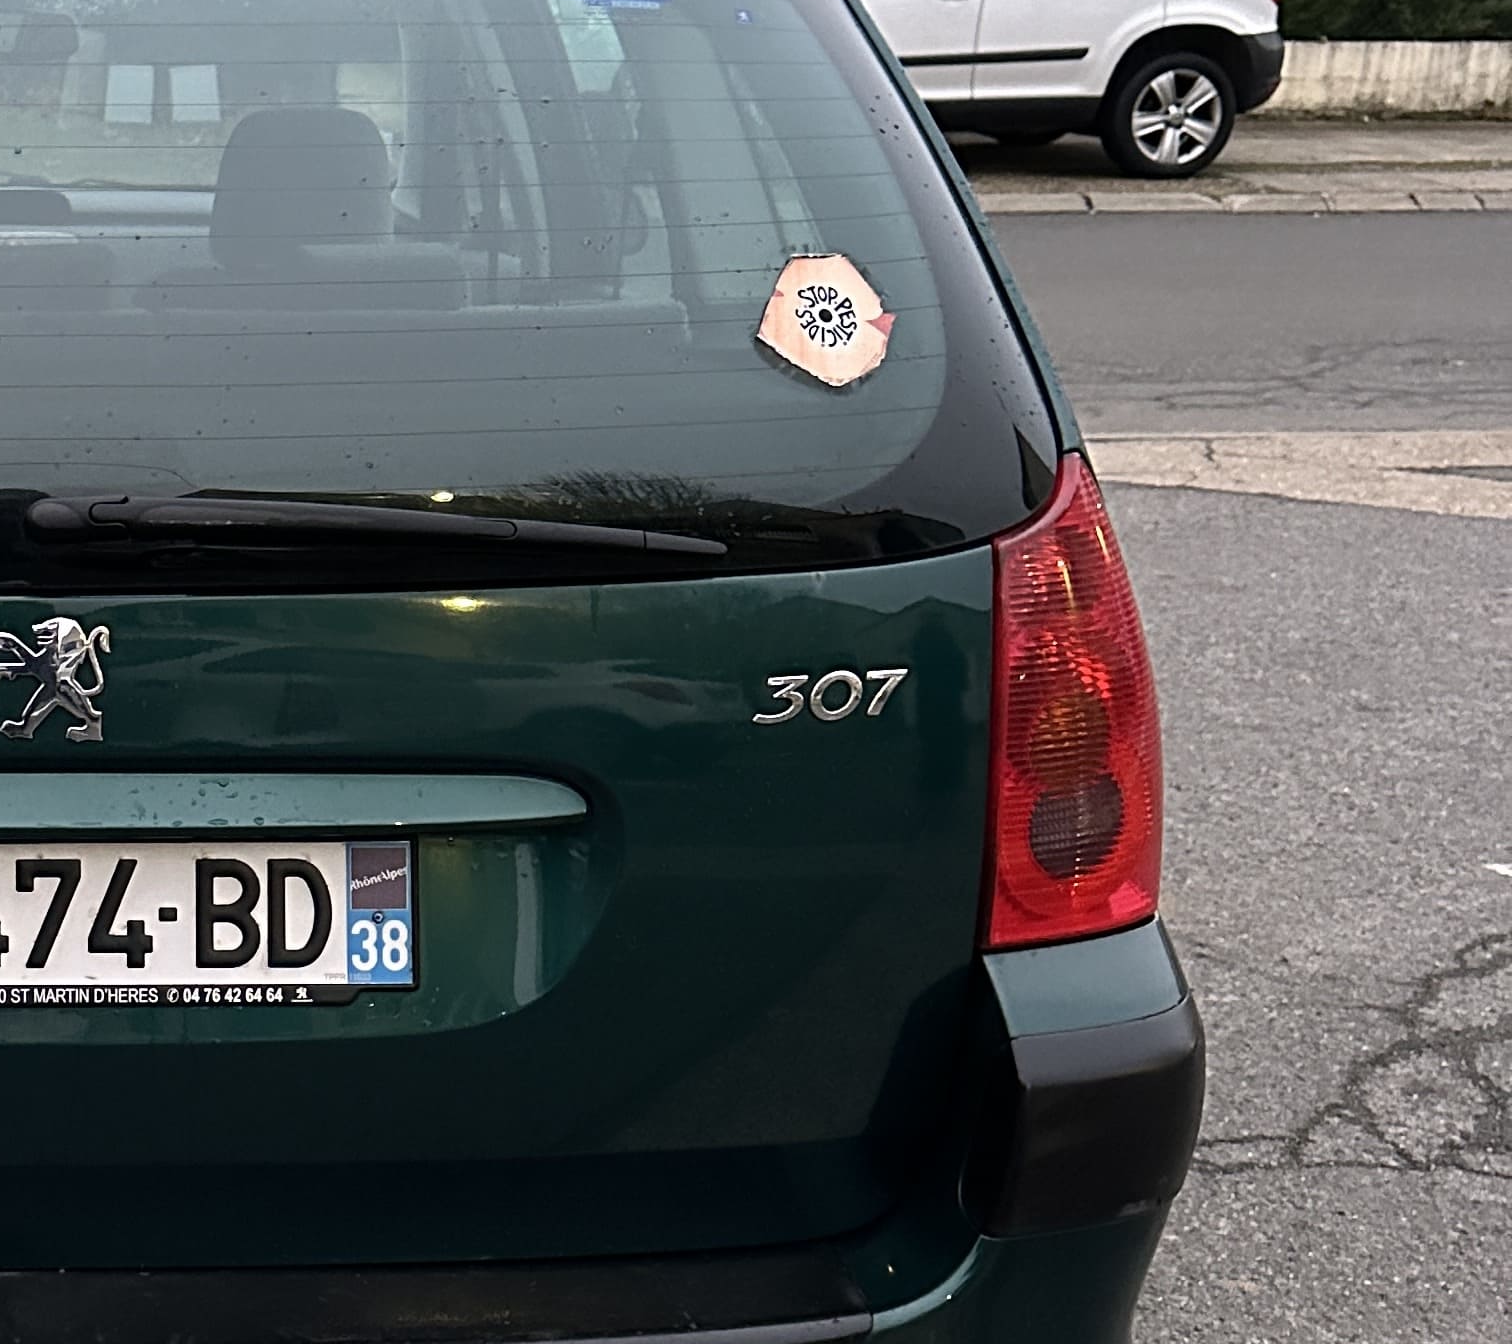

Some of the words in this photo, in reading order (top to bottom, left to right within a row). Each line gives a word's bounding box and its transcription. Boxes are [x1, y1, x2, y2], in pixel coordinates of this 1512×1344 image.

[751, 668, 909, 724] 307
[351, 919, 409, 972] 38
[10, 988, 31, 1004] ST
[33, 988, 90, 1004] MARTIN
[93, 988, 159, 1004] D'HERES
[182, 988, 201, 1004] 04
[203, 988, 221, 1004] 76
[223, 988, 242, 1004] 42
[245, 988, 263, 1004] 64
[265, 988, 284, 1004] 64
